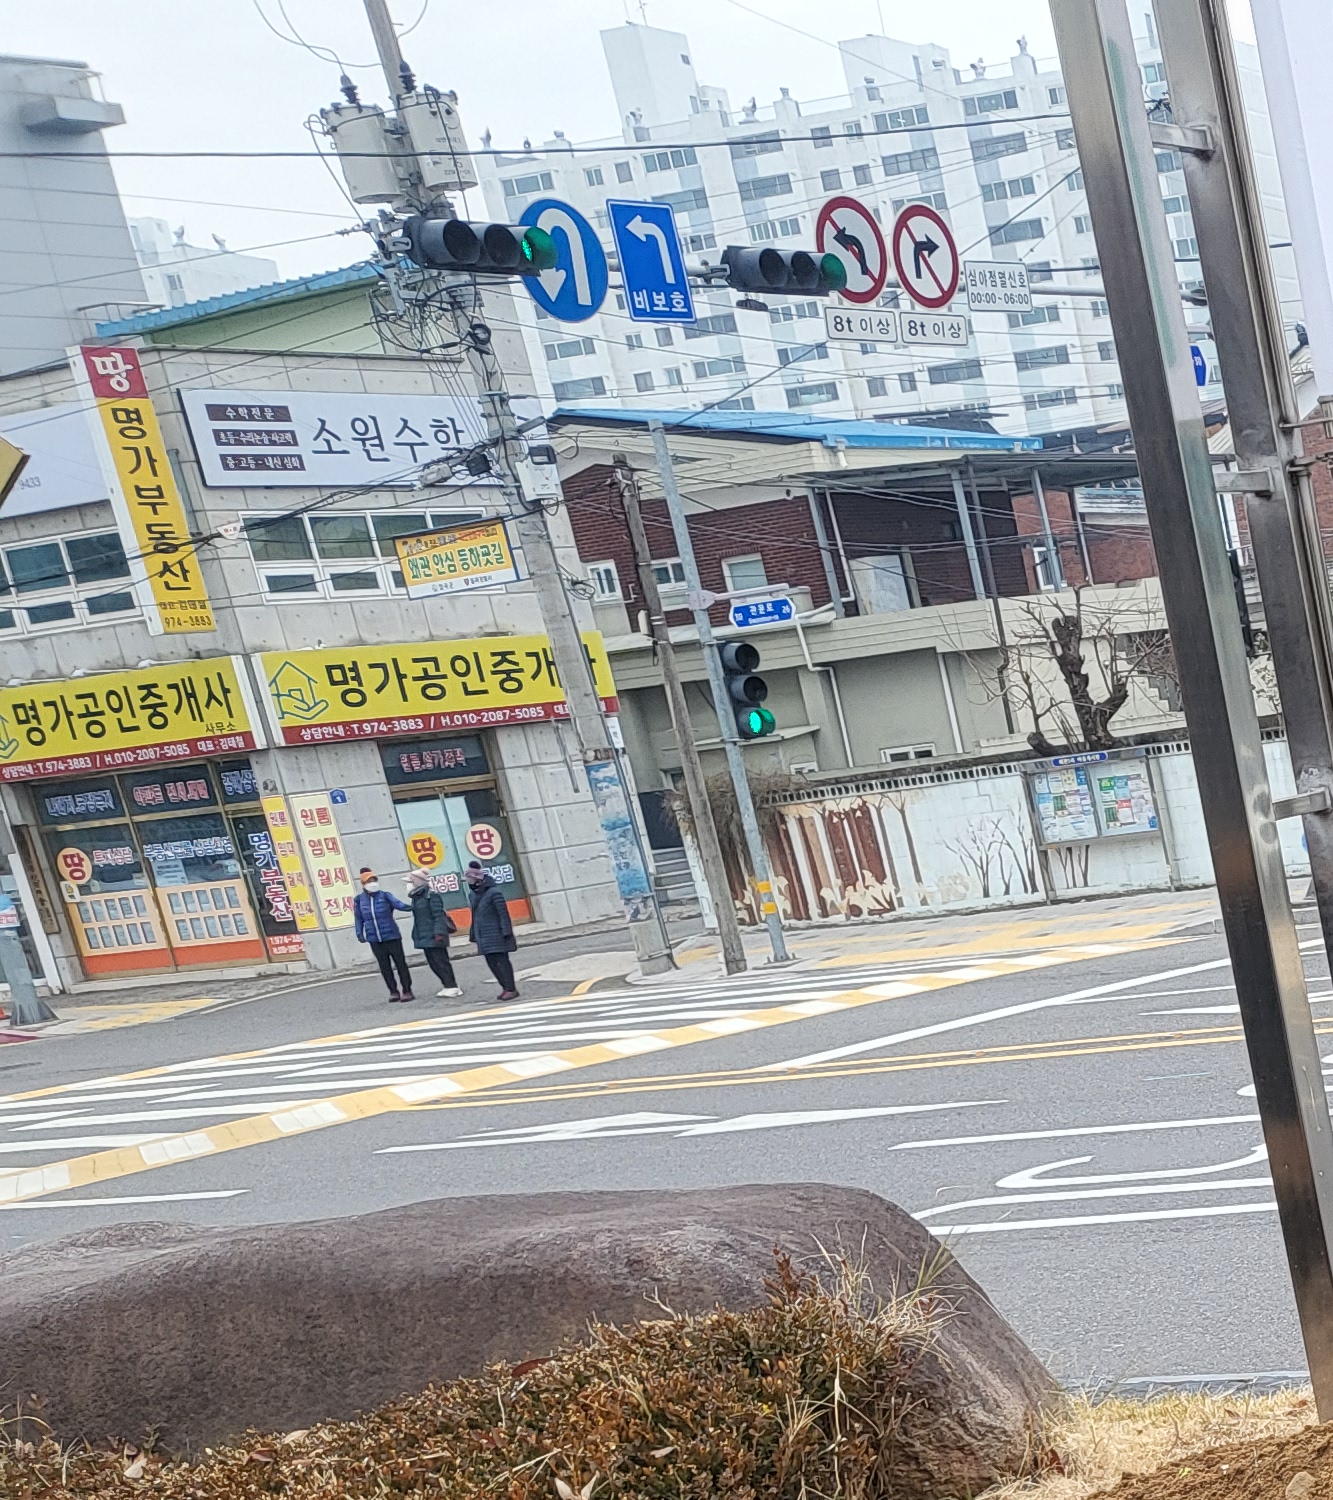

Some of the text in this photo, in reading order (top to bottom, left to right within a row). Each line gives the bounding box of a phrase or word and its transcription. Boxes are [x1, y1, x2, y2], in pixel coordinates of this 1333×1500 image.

[632, 288, 689, 313] 비보호
[833, 315, 891, 335] 8t 이상
[907, 319, 962, 339] 8t 이상
[90, 352, 134, 393] 땅
[311, 414, 470, 464] 소원수학
[111, 406, 192, 591] 명가부동산
[432, 550, 458, 576] 안심
[11, 671, 235, 747] 명가공인중개사
[205, 720, 238, 735] 사무소
[300, 806, 333, 829] 원룸
[308, 837, 342, 859] 임대
[411, 836, 438, 866] 땅
[469, 828, 495, 857] 땅
[62, 852, 87, 881] 땅
[248, 831, 294, 923] 명가부동산
[317, 866, 349, 888] 월세
